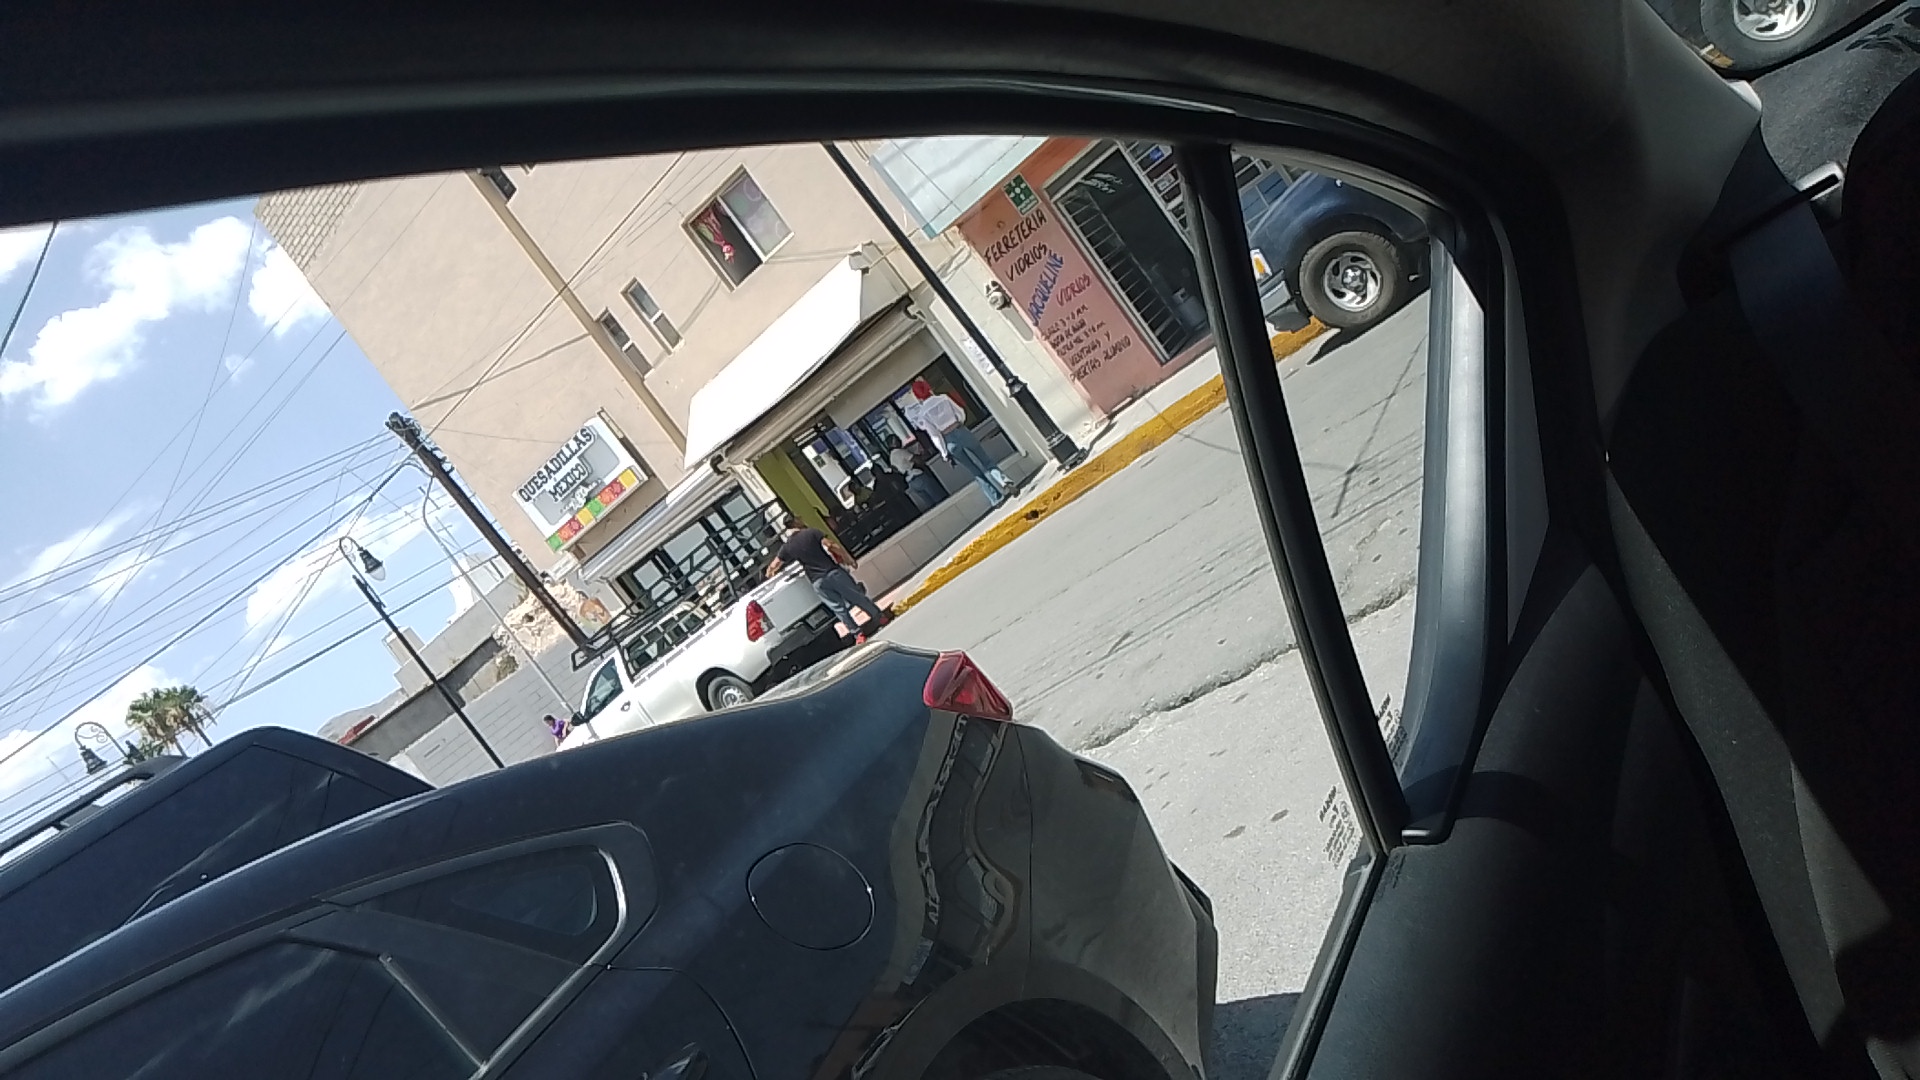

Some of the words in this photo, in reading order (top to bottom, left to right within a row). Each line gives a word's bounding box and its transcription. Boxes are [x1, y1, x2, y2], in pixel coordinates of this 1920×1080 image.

[984, 209, 1047, 268] FERRETERIA
[1005, 242, 1048, 282] VIDRIOS
[1028, 249, 1064, 327] JACQUELINE
[1056, 274, 1091, 306] VIDRIOS
[519, 428, 592, 502] QUESADILLAS
